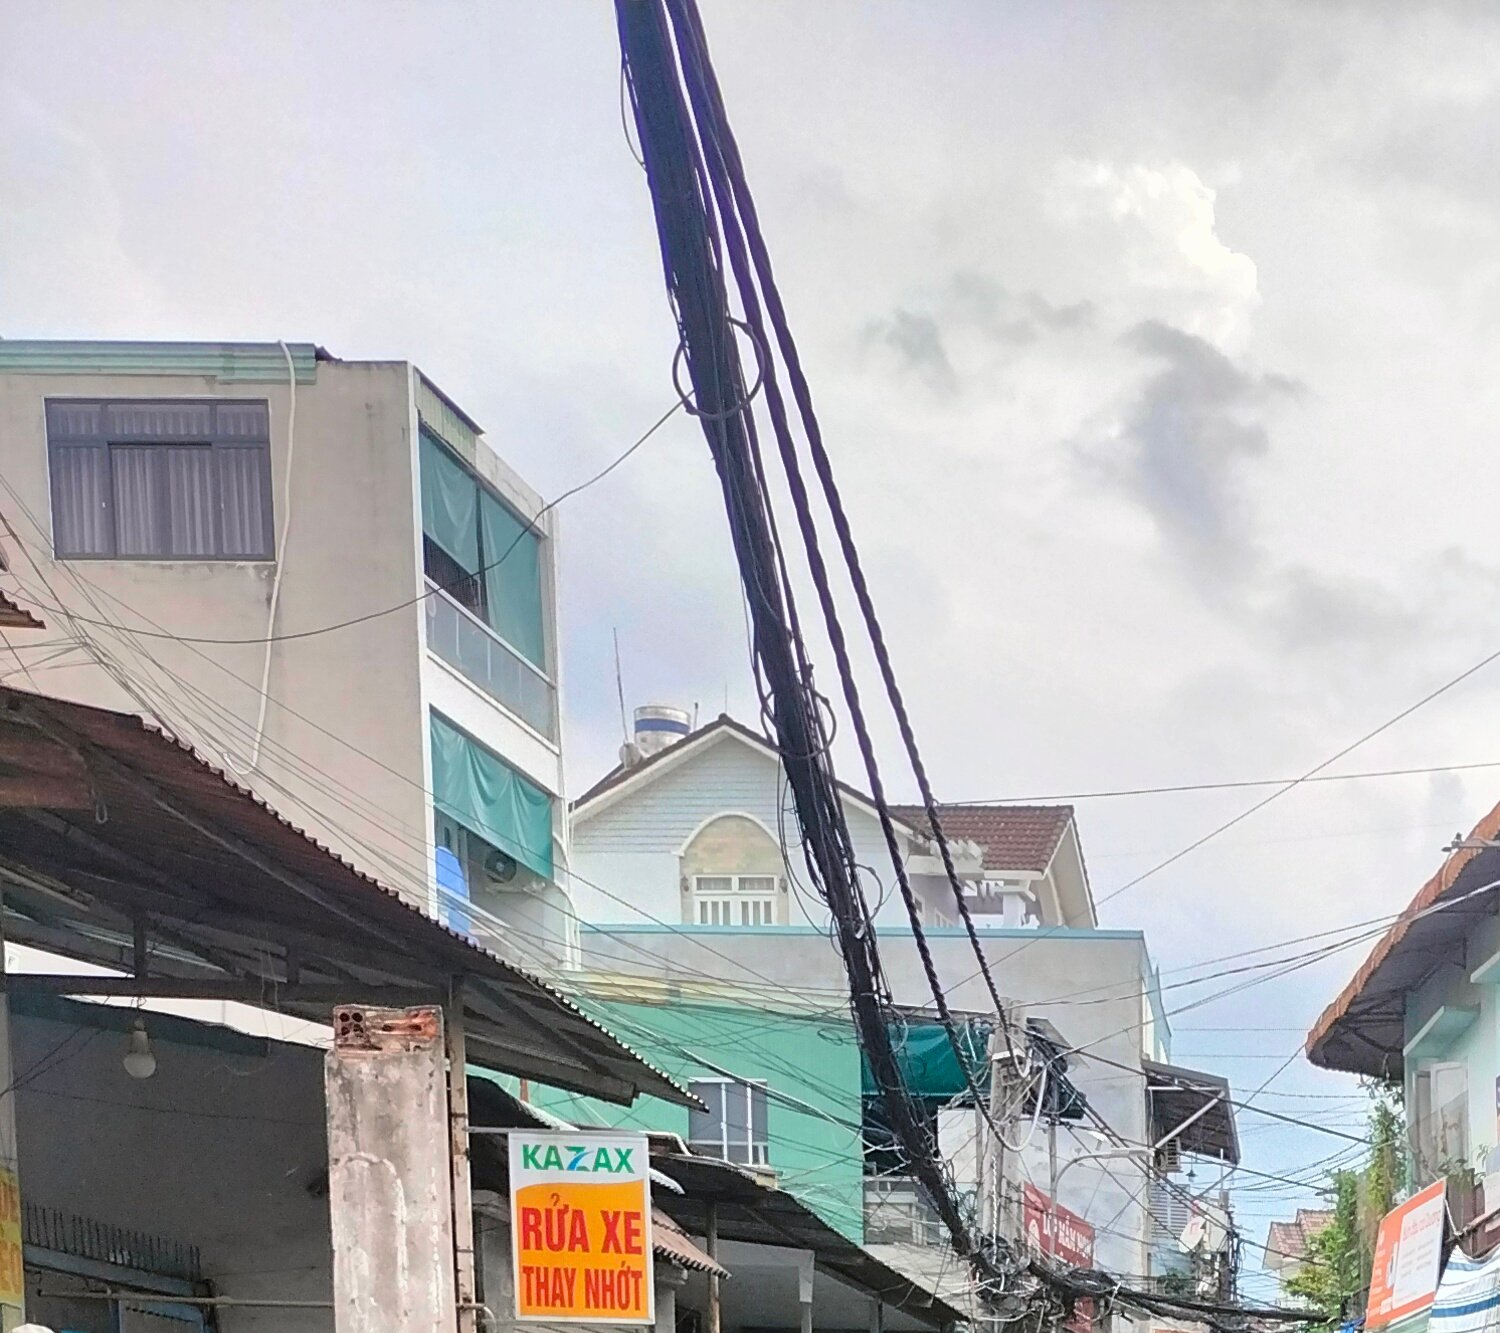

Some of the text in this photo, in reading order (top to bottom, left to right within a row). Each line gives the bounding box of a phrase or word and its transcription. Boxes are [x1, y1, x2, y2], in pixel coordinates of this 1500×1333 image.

[522, 1144, 636, 1174] KAZAX
[522, 1192, 643, 1255] RỬA XE
[522, 1260, 643, 1311] THAY NHỚT
